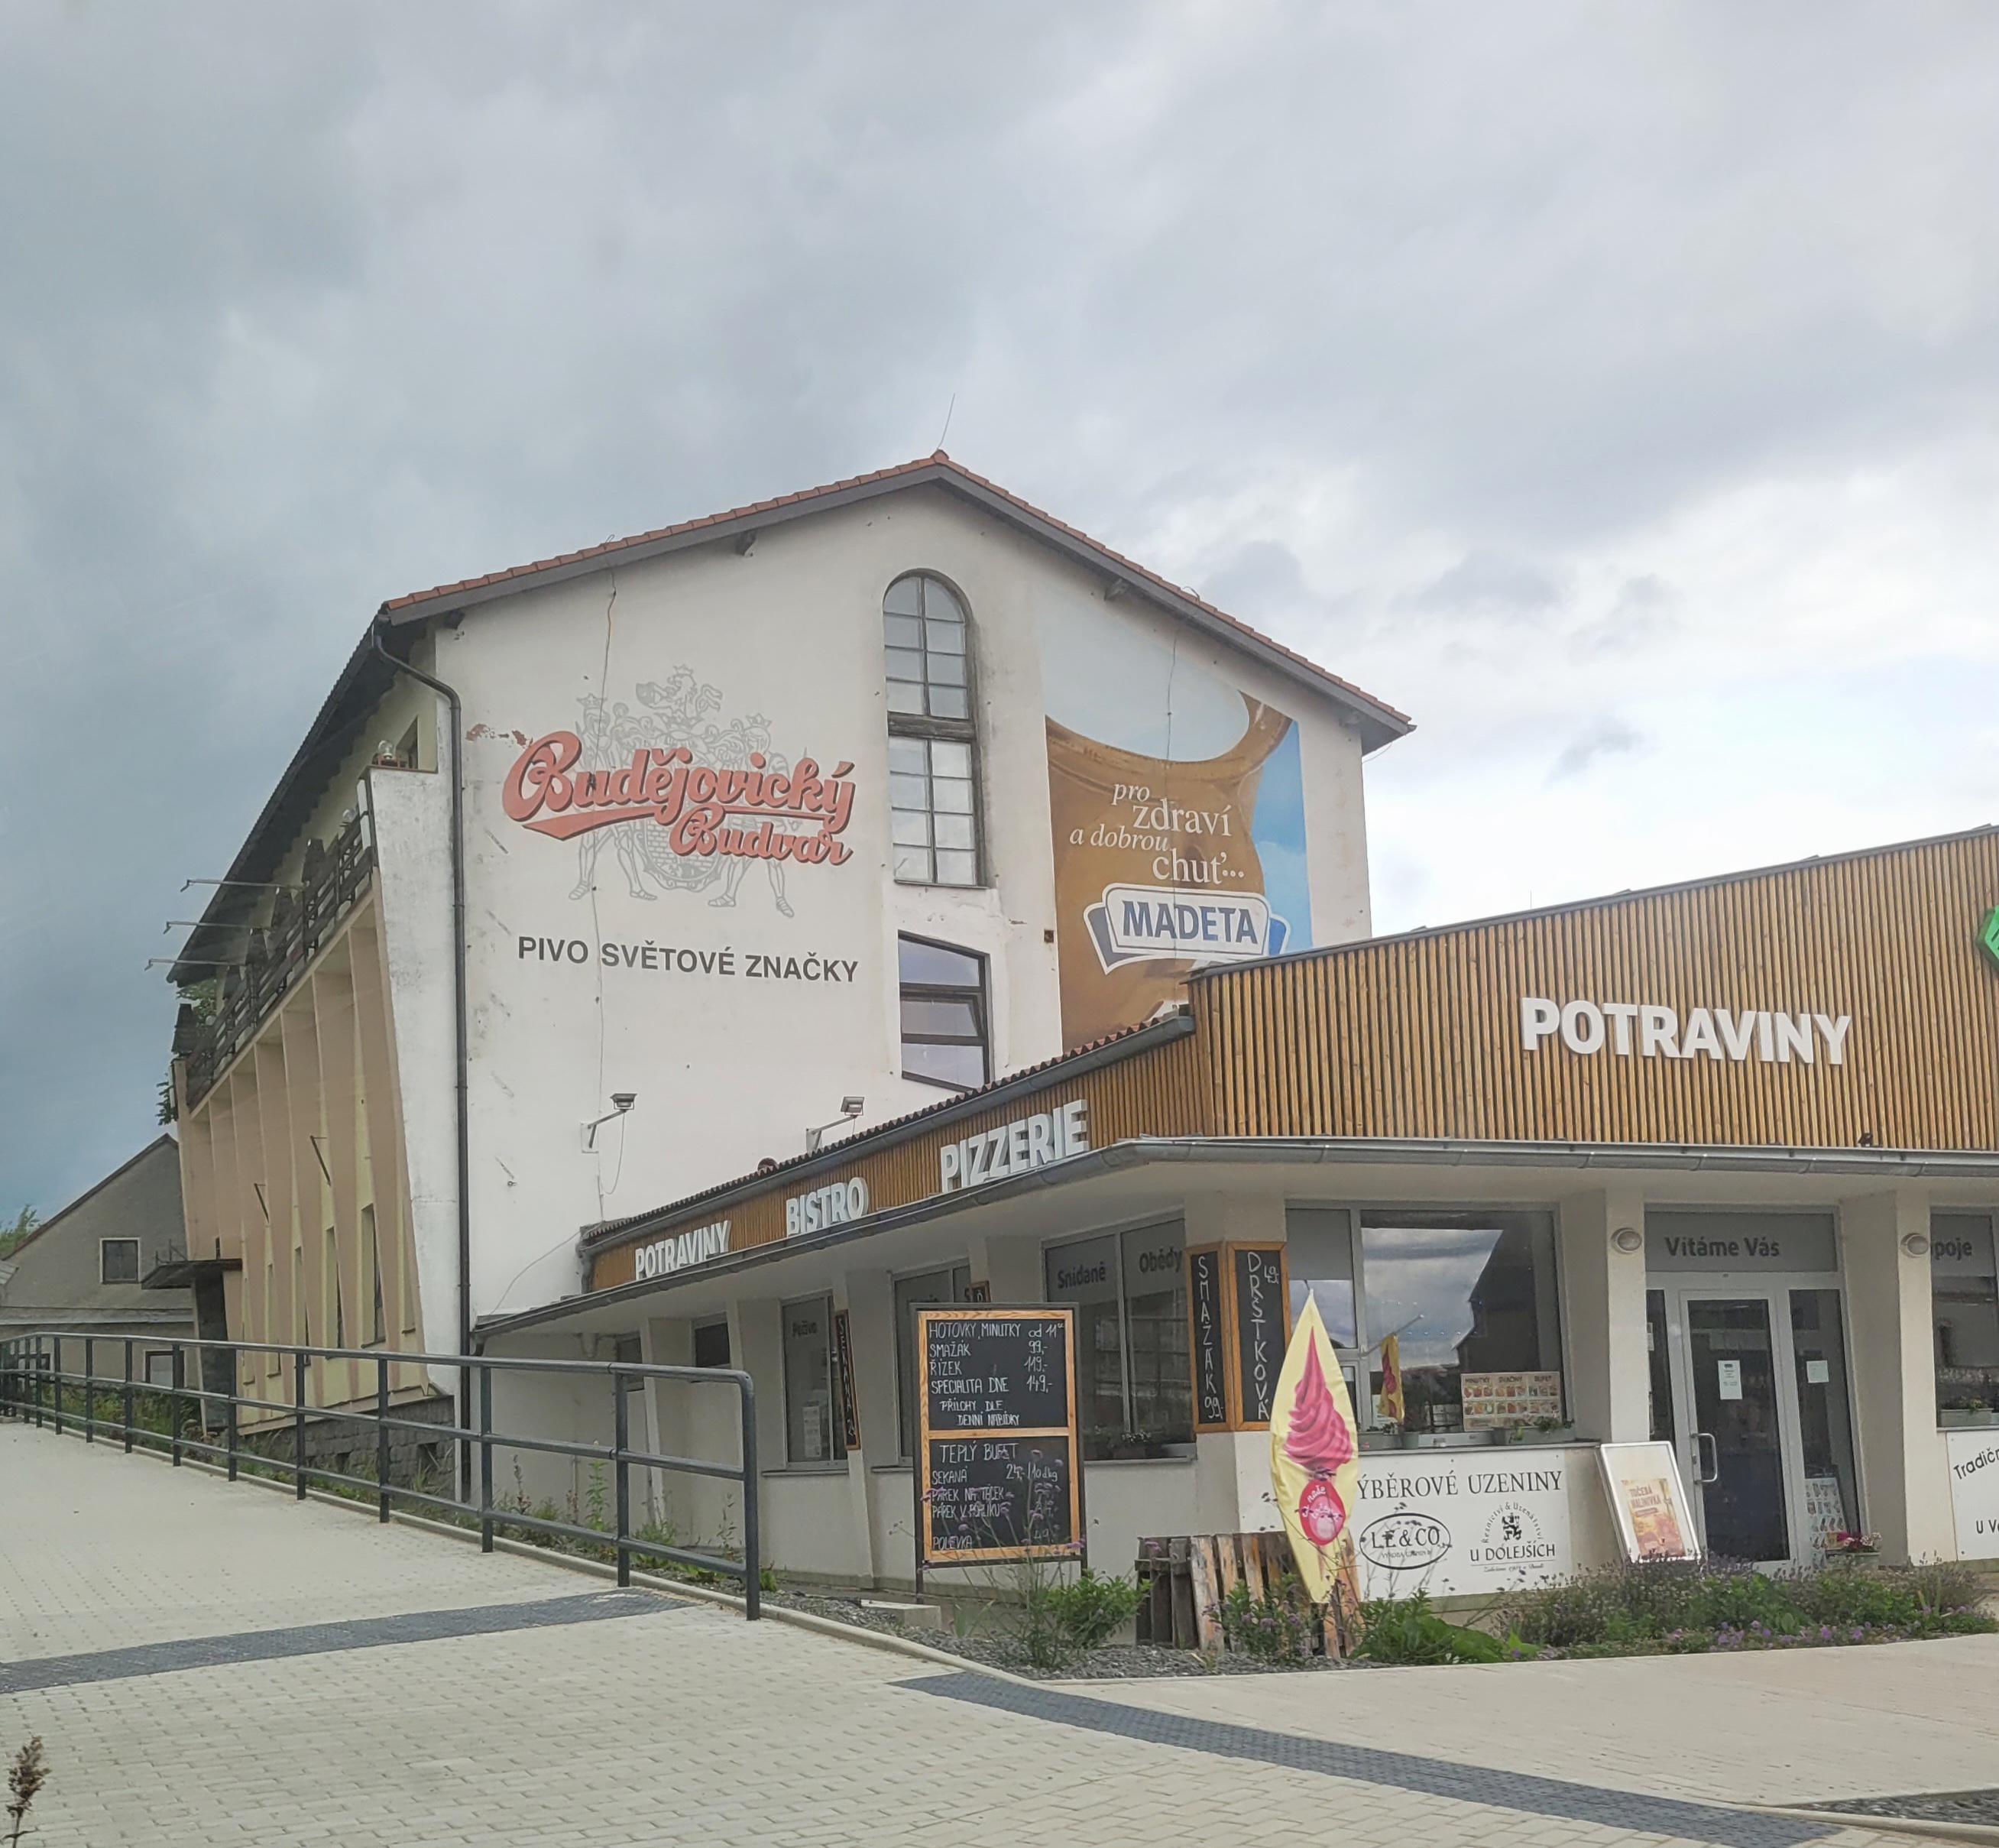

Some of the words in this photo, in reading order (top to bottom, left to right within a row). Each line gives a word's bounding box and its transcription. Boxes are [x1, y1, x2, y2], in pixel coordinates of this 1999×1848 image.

[502, 731, 857, 835] Budějovický
[1111, 783, 1150, 806] pro
[1132, 797, 1232, 837] zdraví
[669, 802, 854, 866] Budvar
[1070, 828, 1084, 846] a
[1090, 823, 1168, 852] dobrou
[1122, 900, 1259, 945] MADETA
[518, 935, 588, 965] PIVO
[601, 940, 736, 976] SVĚTOVÉ
[745, 952, 859, 983] ZNAČKY
[1521, 997, 1852, 1065] POTRAVINY
[940, 1099, 1090, 1193] PIZZERIE
[786, 1176, 868, 1237] BISTRO
[635, 1220, 731, 1281] POTRAVINY
[1744, 1236, 1780, 1256] Vás
[1931, 1237, 1972, 1261] poje
[1139, 1247, 1183, 1274] Obědy
[981, 1323, 1021, 1337] MINUTKY
[1028, 1323, 1042, 1338] od
[1247, 1251, 1270, 1420] DRŠTKOVÁ
[928, 1340, 971, 1358] SMAŽÁK
[928, 1358, 963, 1376] ŘÍZEK
[931, 1378, 983, 1395] SPECIALITA
[988, 1376, 1009, 1393] DNE
[984, 1399, 1004, 1412] DLE
[957, 1411, 984, 1426] DENNÍ
[939, 1439, 978, 1464] TEPLÝ
[931, 1465, 968, 1485] SEKANÁ
[1356, 1470, 1459, 1500] ÝBĚROVÉ
[1467, 1470, 1563, 1495] UZENINY
[1505, 1502, 1511, 1510] &
[1975, 1520, 1984, 1535] U
[1470, 1548, 1479, 1562] U
[1485, 1540, 1556, 1561] DOLEJŠÍCH
